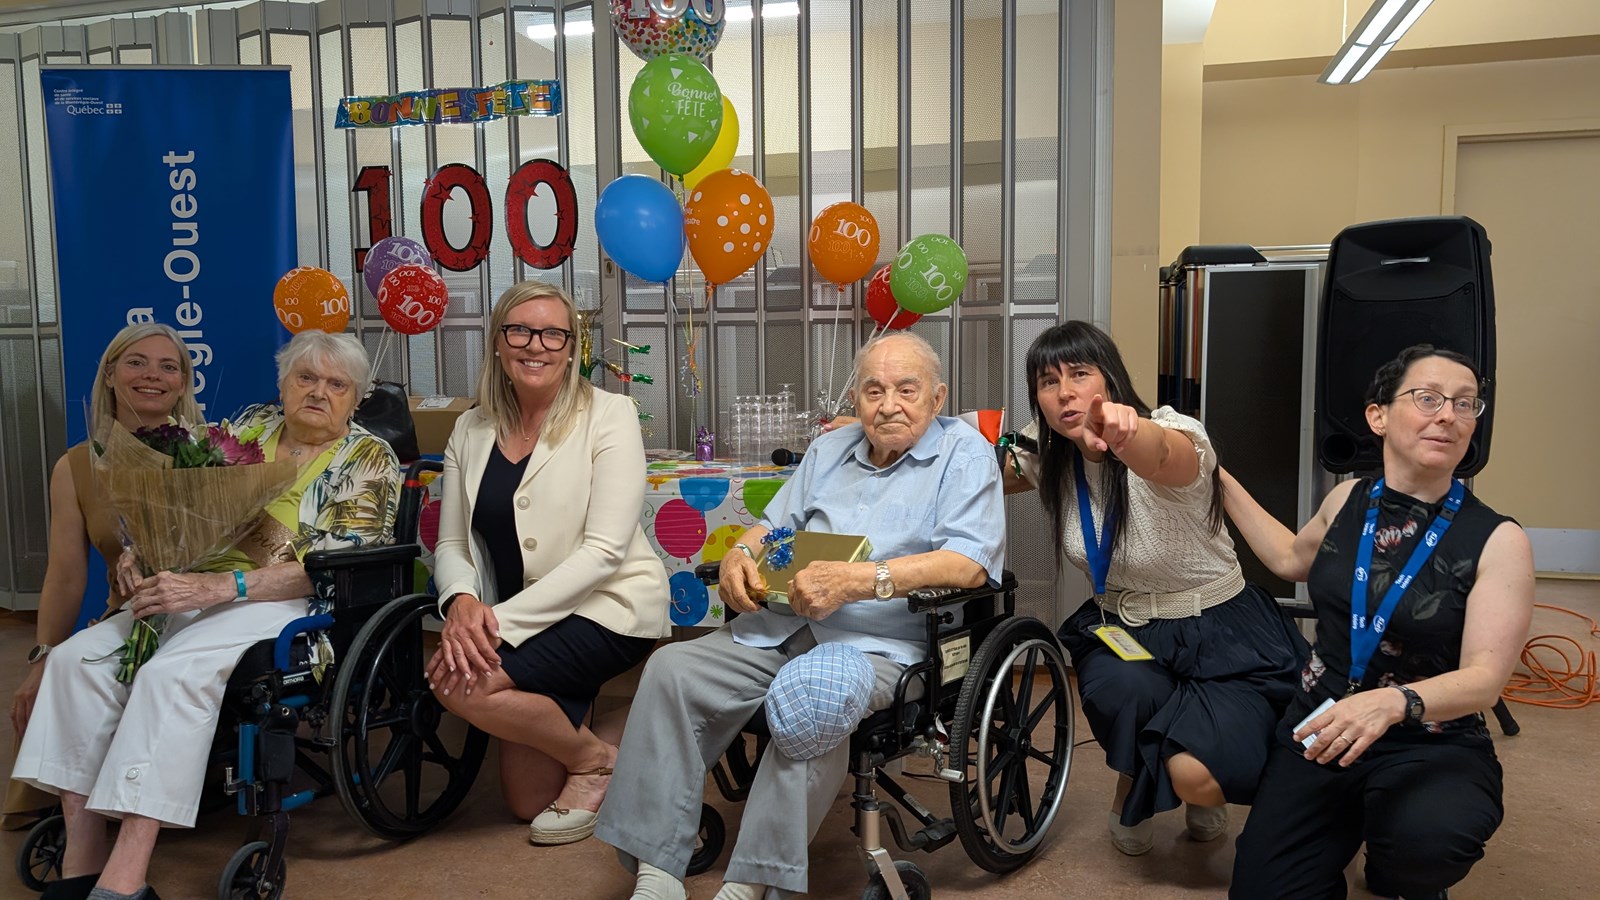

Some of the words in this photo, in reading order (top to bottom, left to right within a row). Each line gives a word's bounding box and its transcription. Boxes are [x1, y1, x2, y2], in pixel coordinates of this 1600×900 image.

[667, 82, 718, 101] Bonne
[66, 105, 105, 116] Québec
[350, 91, 461, 124] BONNE
[474, 83, 552, 117] FÊTE
[676, 97, 706, 118] FÊTE
[352, 159, 579, 273] 100
[833, 219, 871, 247] 100
[920, 262, 953, 301] 100
[285, 297, 299, 306] 100
[320, 295, 349, 317] 100
[396, 294, 435, 326] 100
[427, 295, 442, 305] 100
[277, 308, 303, 328] 00
[1425, 531, 1438, 547] APTS
[1374, 615, 1385, 634] APTS
